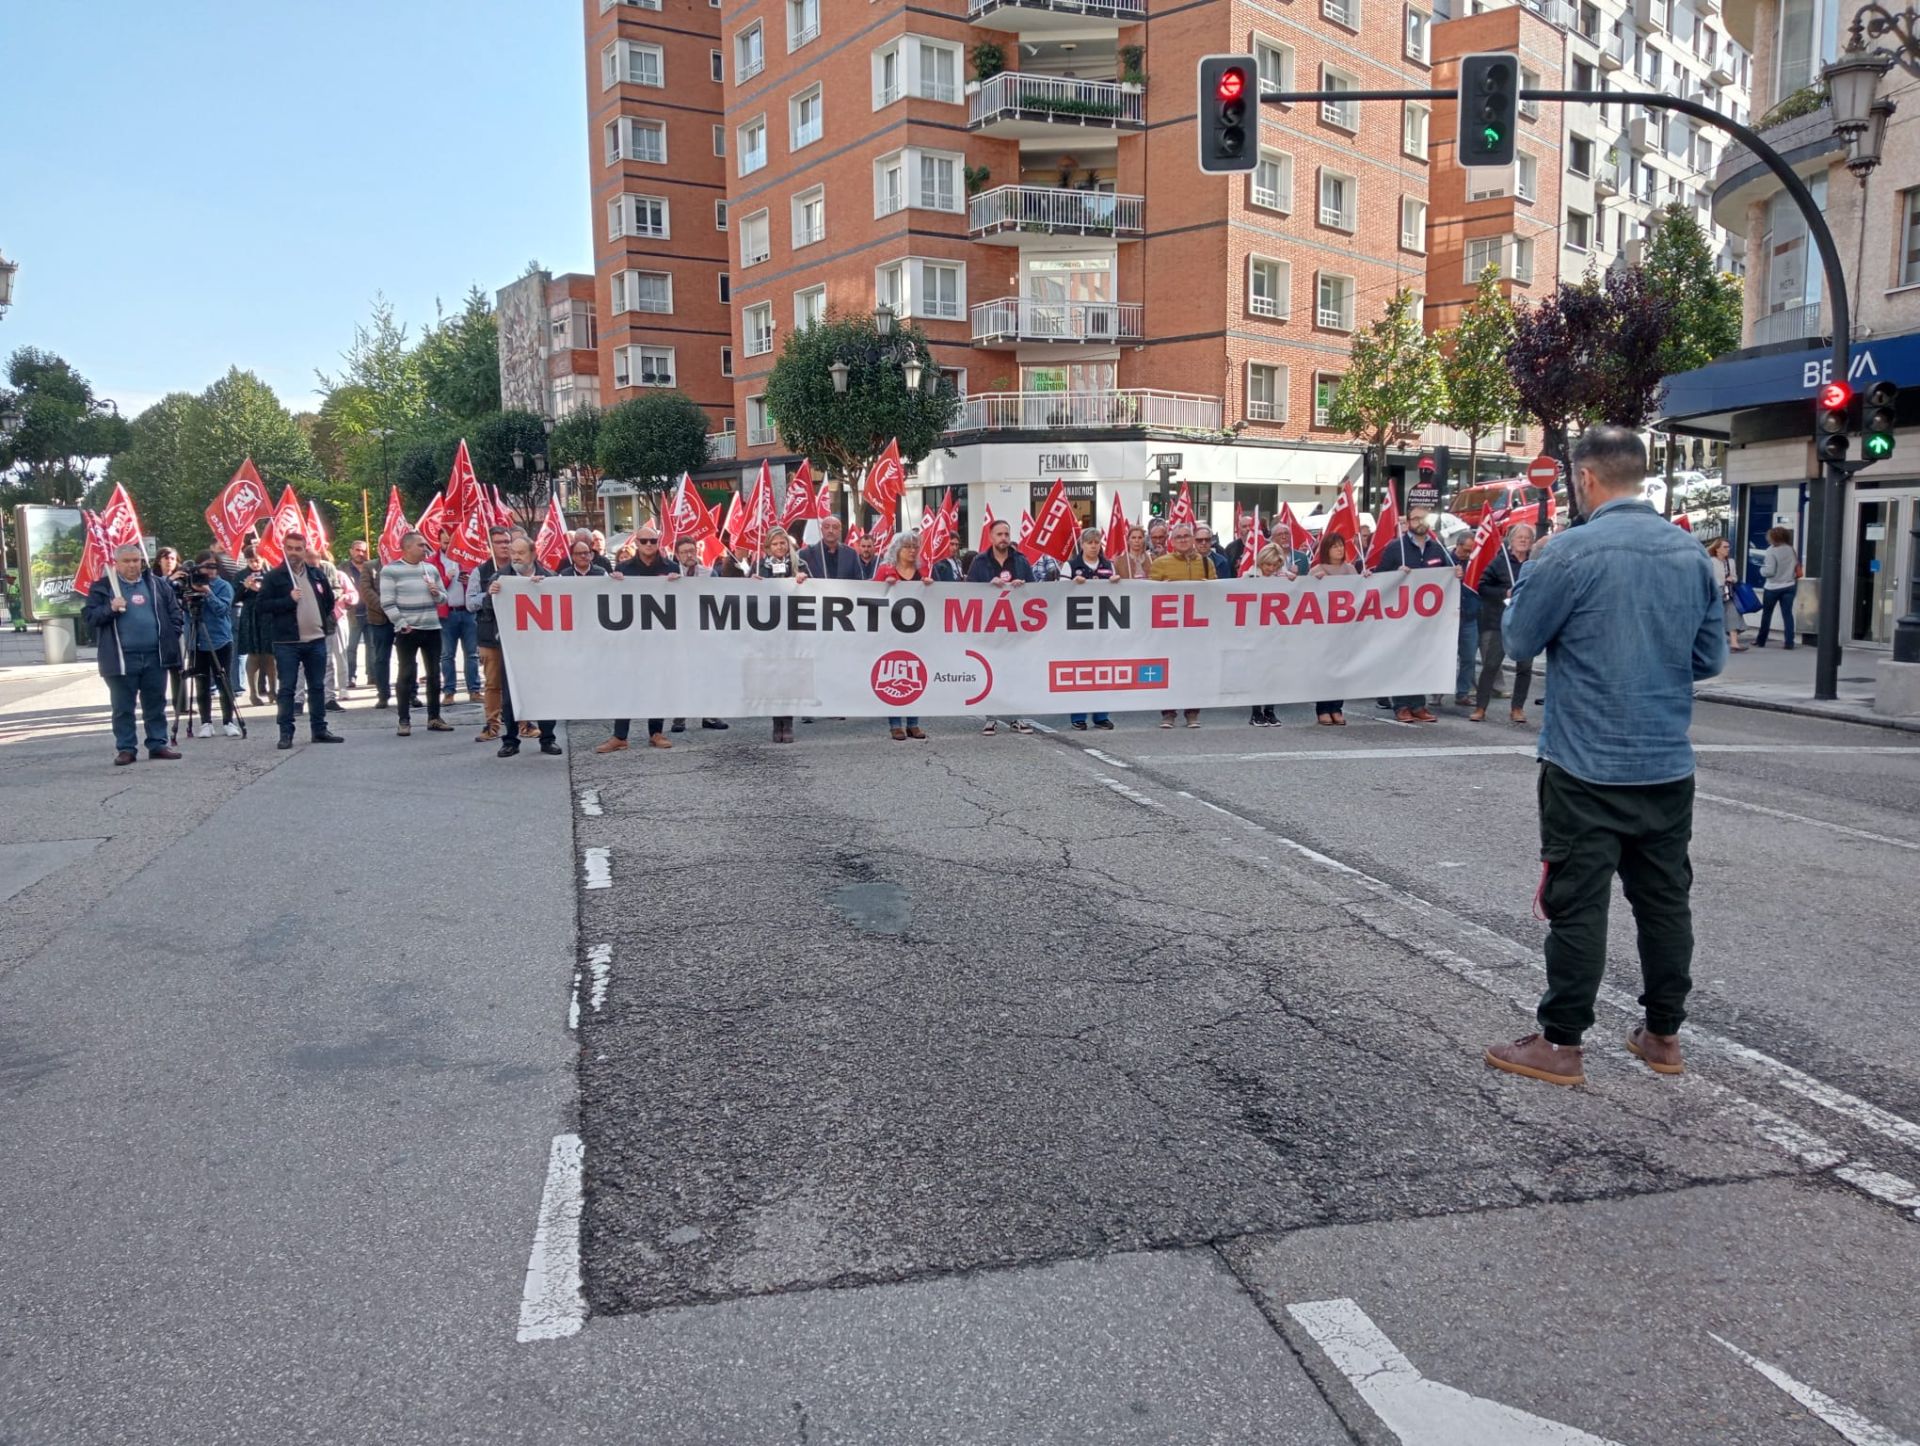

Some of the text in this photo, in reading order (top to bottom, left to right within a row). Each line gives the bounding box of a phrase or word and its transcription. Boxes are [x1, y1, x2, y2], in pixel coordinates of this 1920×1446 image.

[1039, 454, 1089, 476] FERMENTO
[1064, 486, 1094, 496] ANADEROS
[1410, 489, 1439, 498] AUSENTE
[516, 583, 1445, 634] NI UN MUERTO MÁS EN EL TRABAJO
[879, 660, 977, 683] UGT Asturias
[1055, 665, 1133, 686] CCOO
